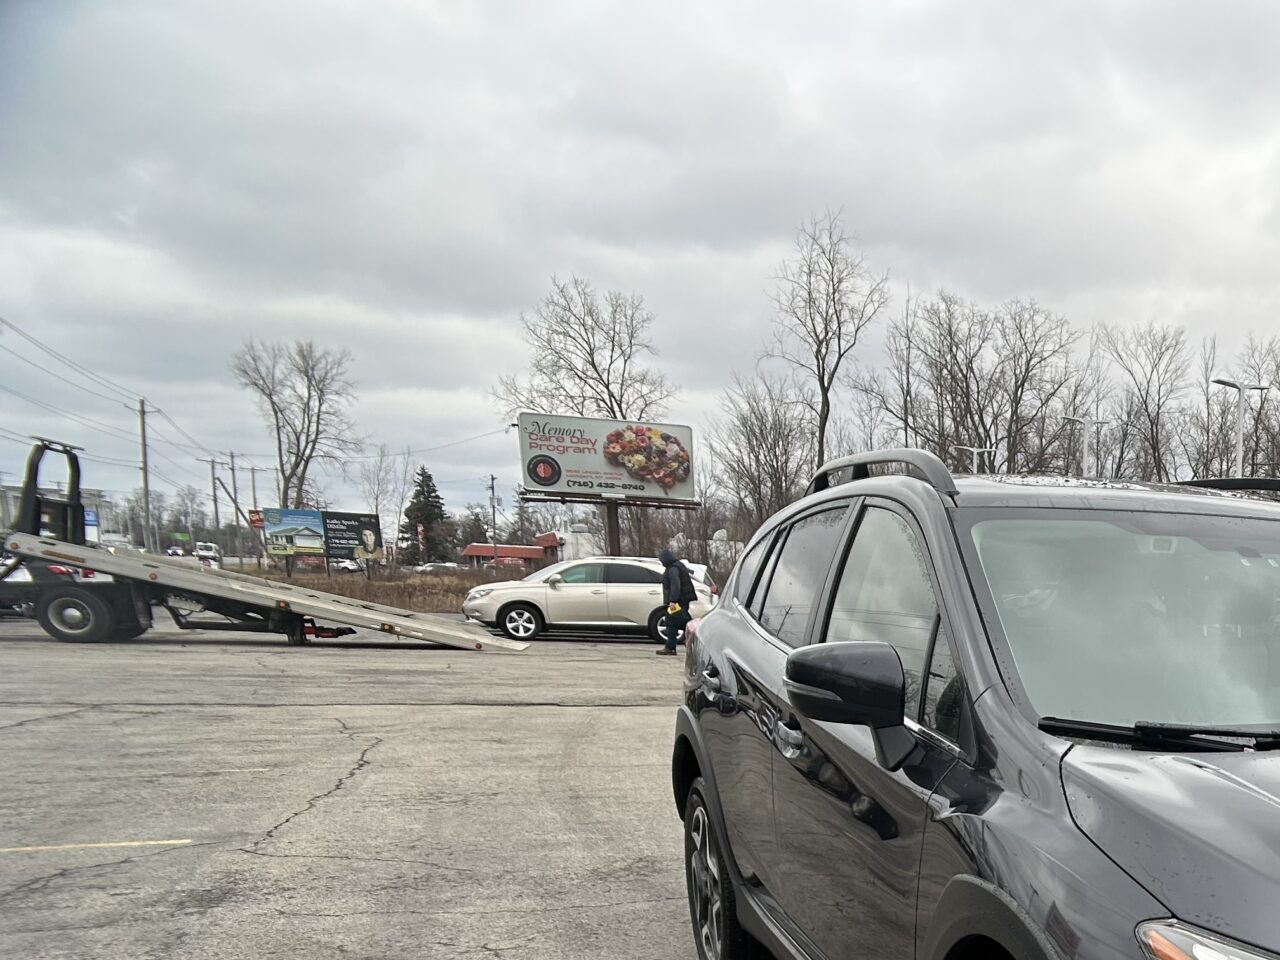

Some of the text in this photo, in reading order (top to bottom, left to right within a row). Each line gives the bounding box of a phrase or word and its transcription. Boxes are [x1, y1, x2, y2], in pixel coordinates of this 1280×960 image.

[523, 421, 585, 438] Memory
[529, 433, 597, 447] Care Day
[529, 442, 597, 454] Program
